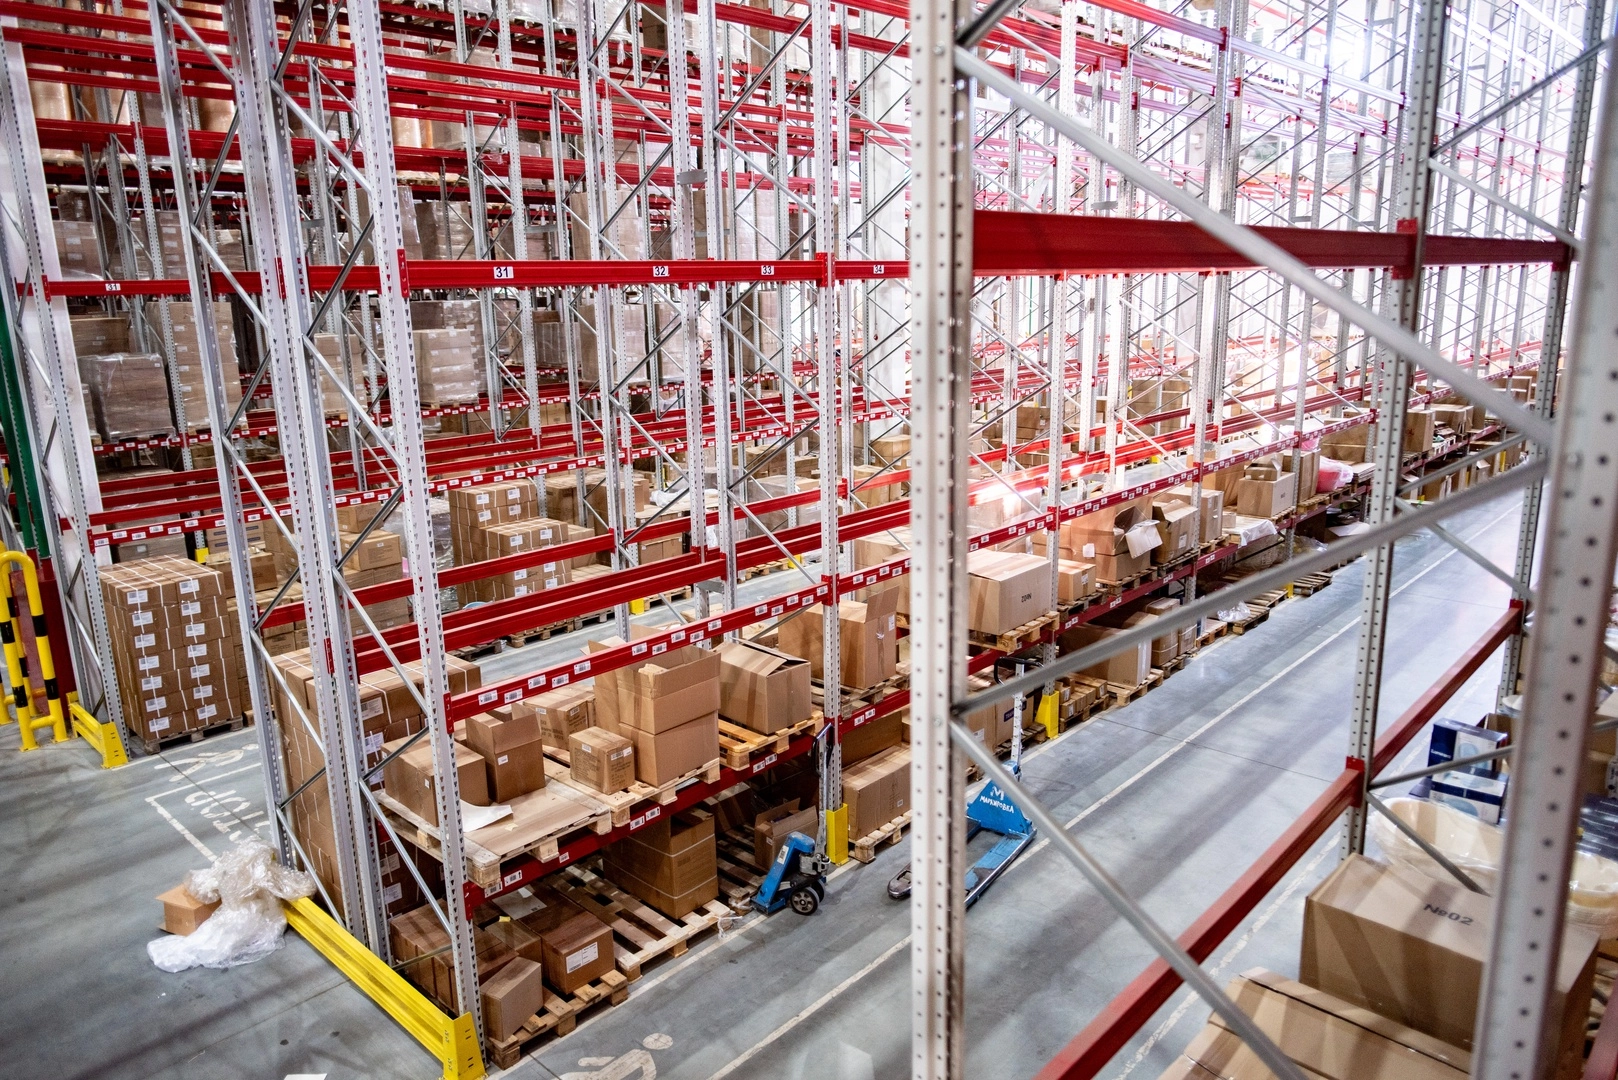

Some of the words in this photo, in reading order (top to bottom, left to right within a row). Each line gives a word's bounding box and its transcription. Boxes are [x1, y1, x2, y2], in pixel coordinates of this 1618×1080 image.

[495, 266, 509, 278] 31
[654, 265, 666, 276] 32
[762, 265, 772, 275] 33
[874, 264, 883, 274] 34
[1423, 903, 1474, 926] №02
